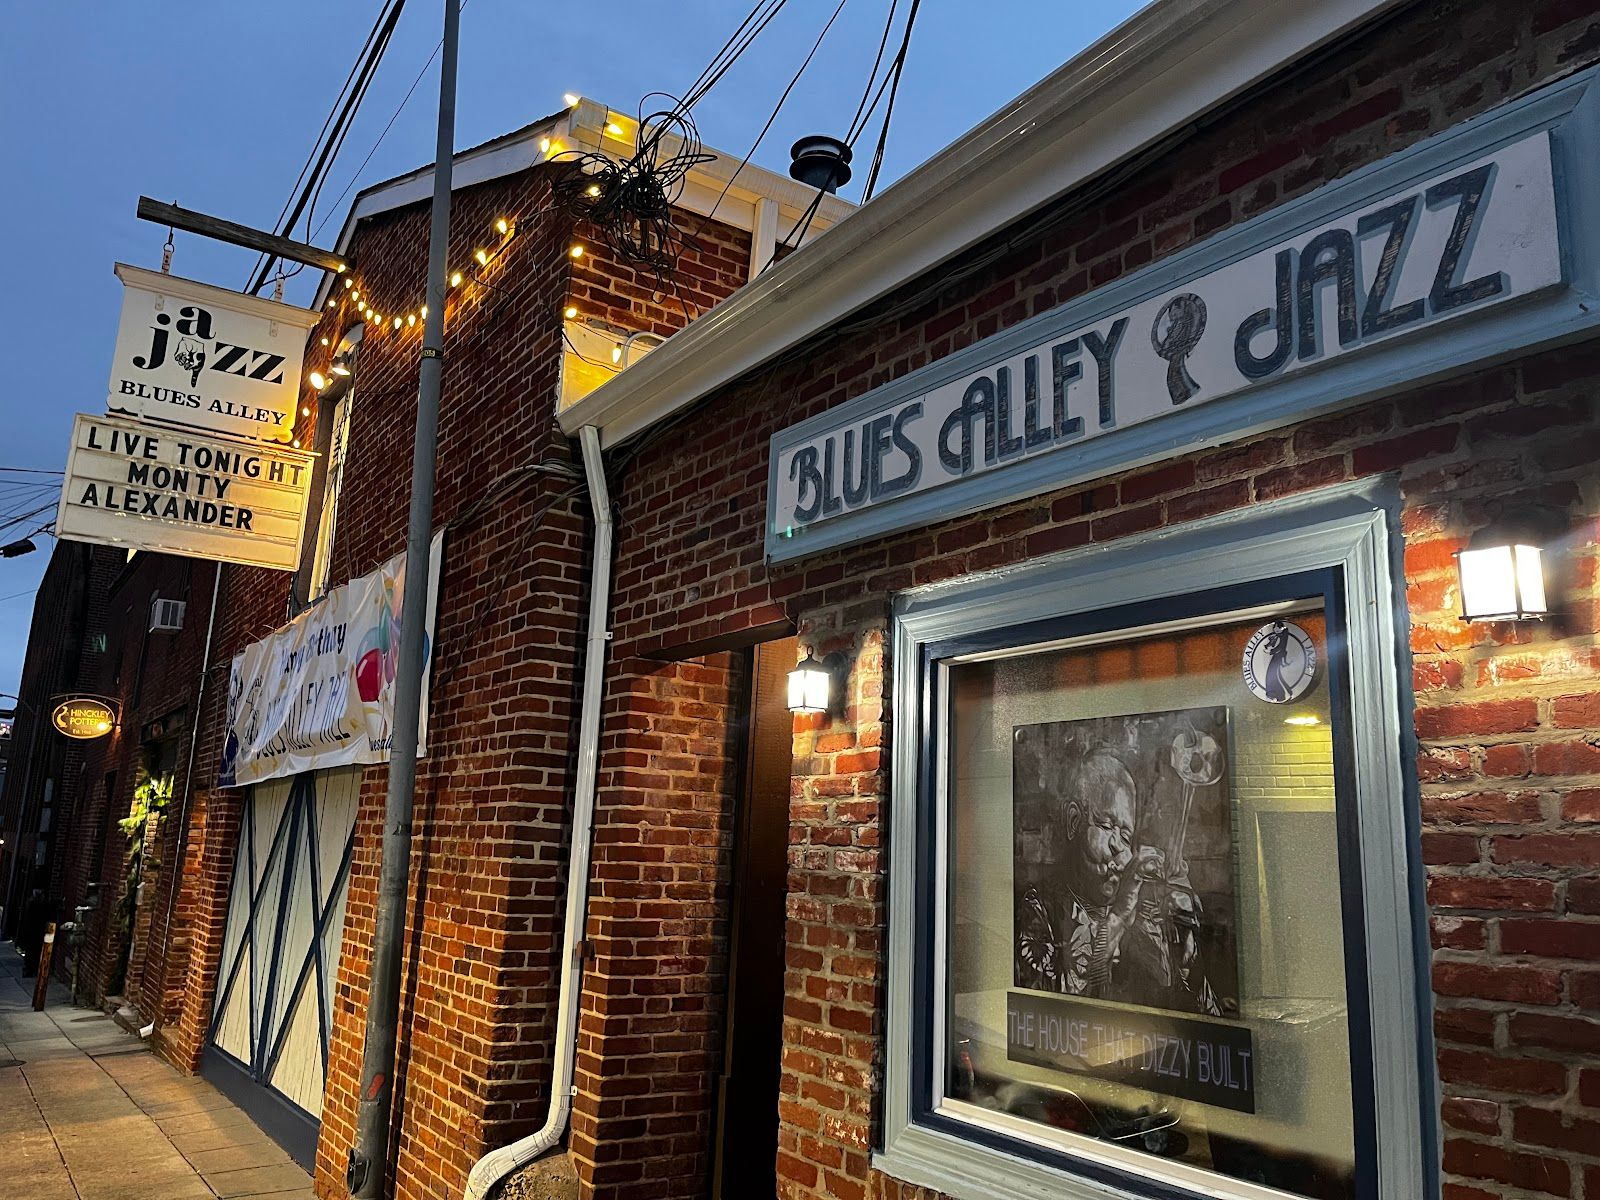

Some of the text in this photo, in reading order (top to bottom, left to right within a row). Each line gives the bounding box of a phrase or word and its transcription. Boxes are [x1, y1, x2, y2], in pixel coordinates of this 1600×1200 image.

[789, 161, 1511, 524] BLUES ALLEY JAZZ
[118, 379, 287, 426] BLUES ALLEY
[88, 426, 305, 485] LIVE TONIGHT
[127, 462, 232, 499] MONTY
[80, 483, 254, 531] ALEXANDER
[1245, 629, 1265, 658] ALLEY
[70, 708, 111, 718] HINCKLEY
[70, 716, 105, 725] POTTER
[1008, 1010, 1251, 1091] THE HOUSE THAT DIZZY BUILT
